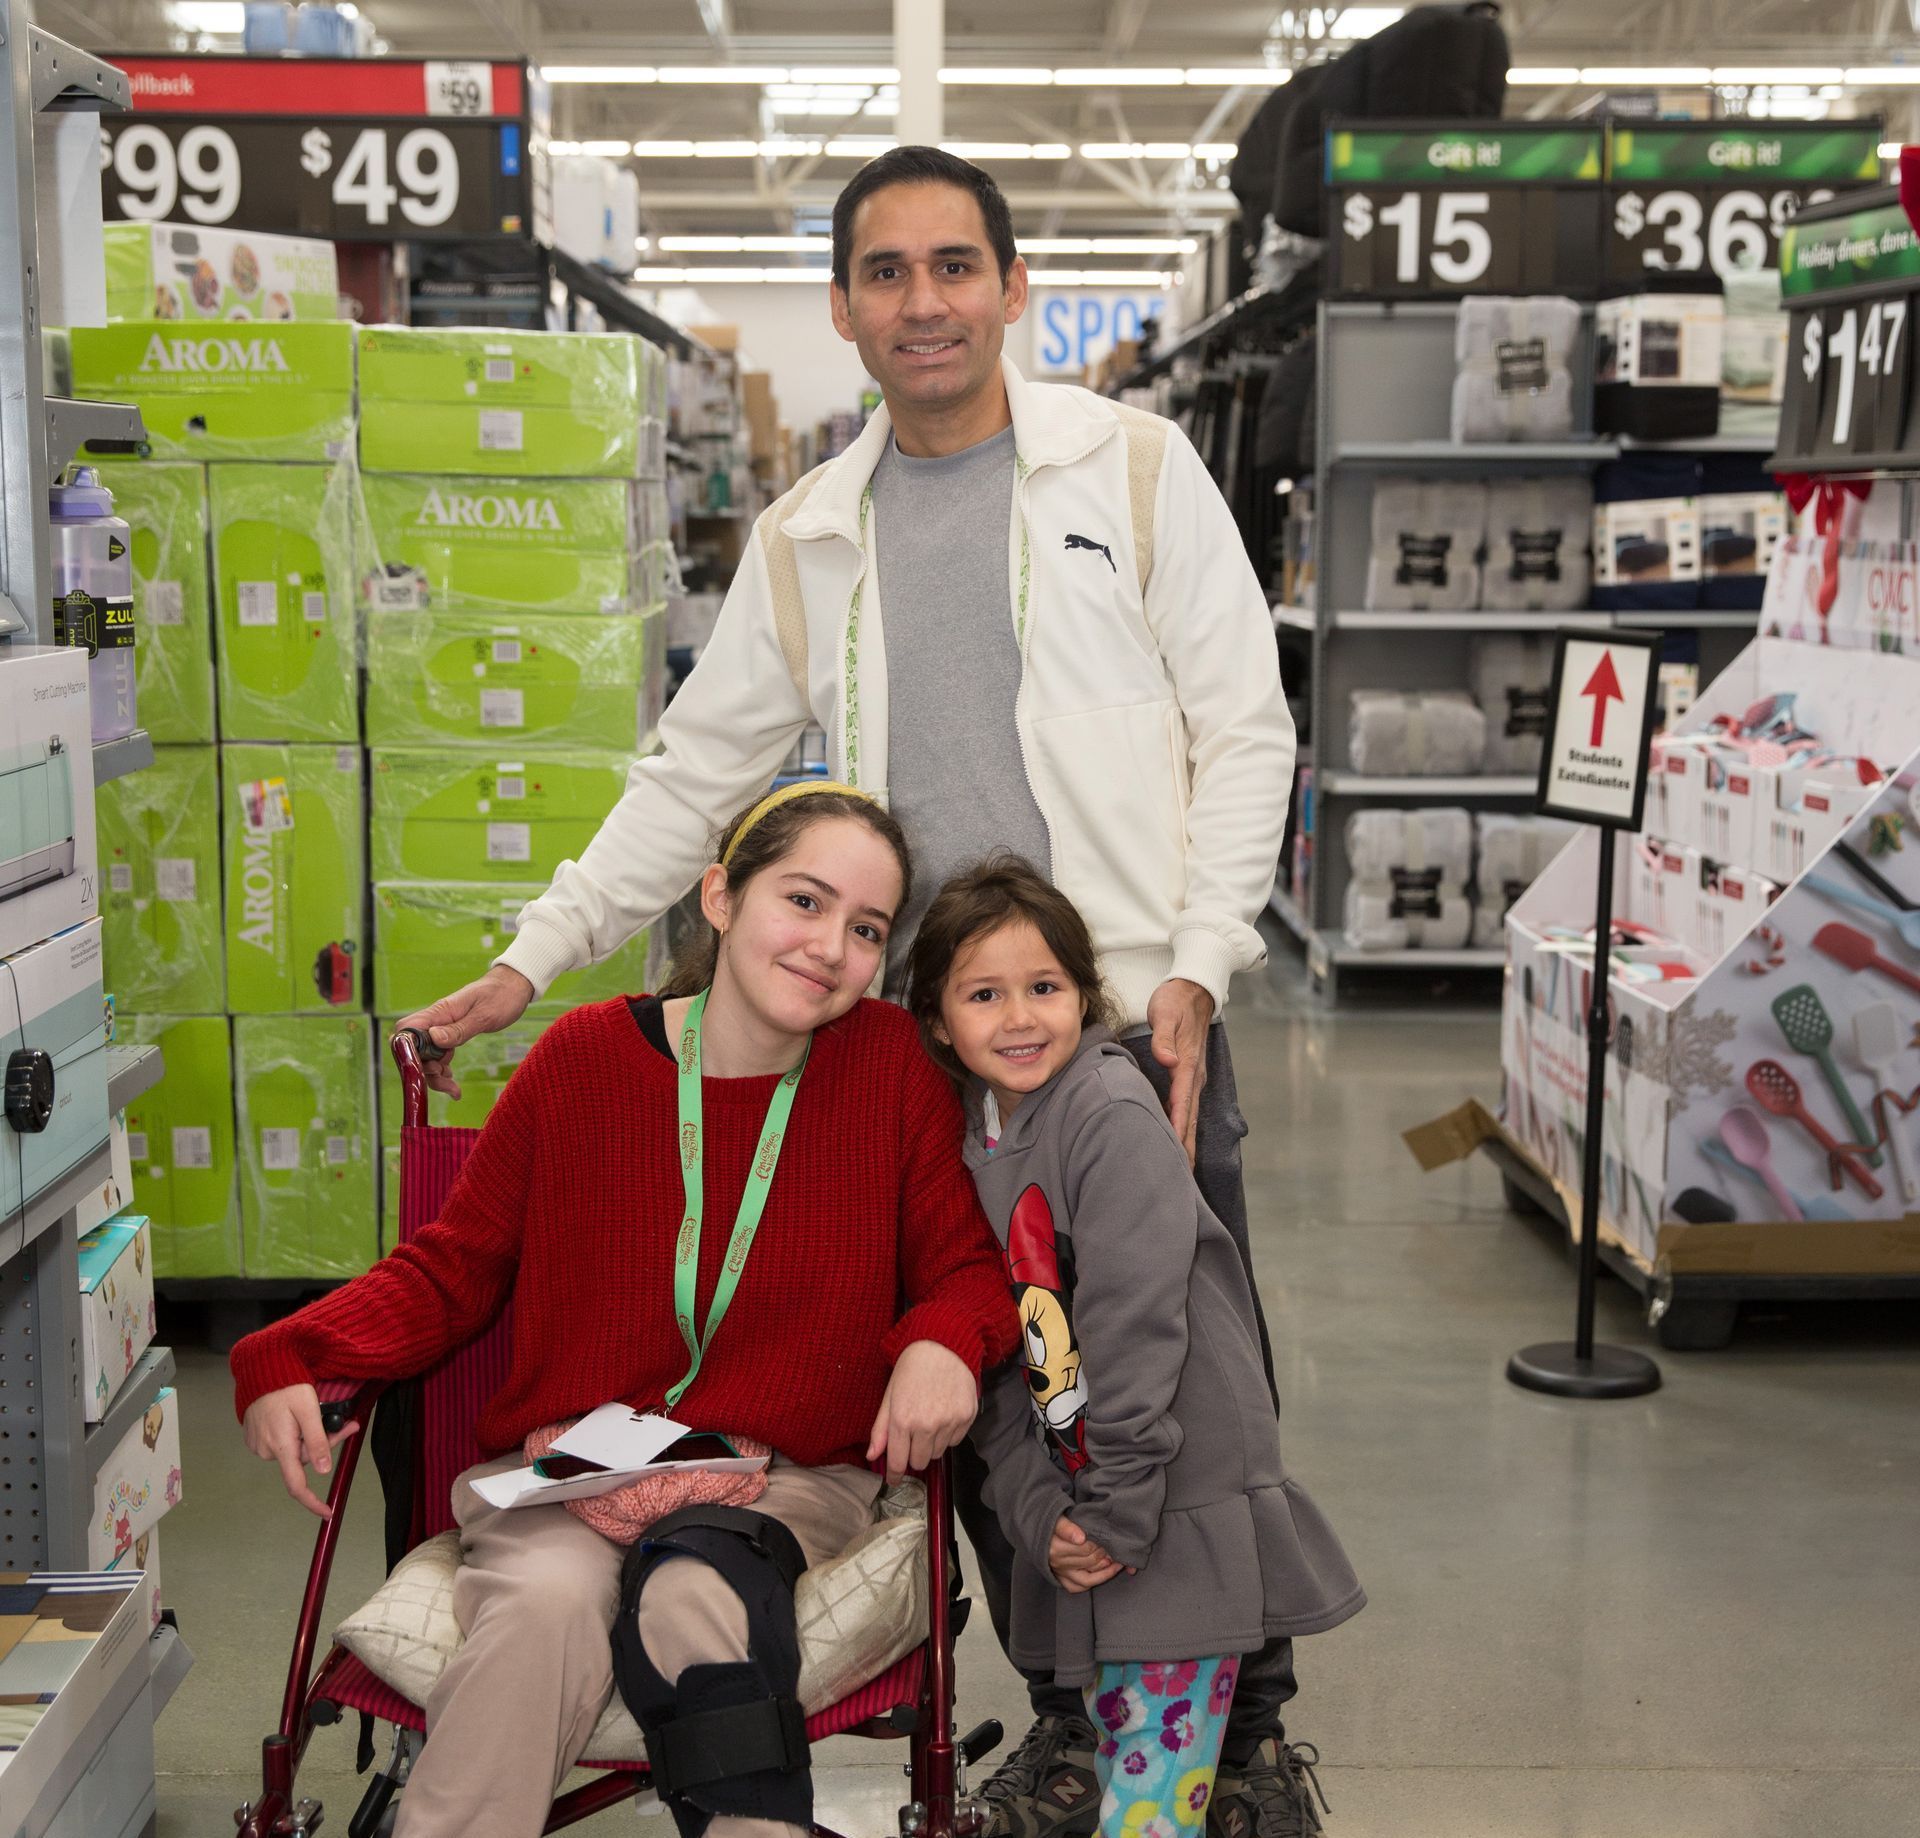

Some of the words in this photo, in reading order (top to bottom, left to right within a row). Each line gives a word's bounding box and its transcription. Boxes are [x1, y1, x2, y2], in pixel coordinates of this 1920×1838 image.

[130, 73, 195, 96] ollback
[1427, 142, 1474, 168] Gift
[1707, 140, 1754, 167] Gift
[301, 127, 460, 227] $49
[1343, 192, 1492, 283] $15
[1044, 296, 1164, 367] SPO
[139, 330, 291, 372] AROMA
[415, 487, 564, 531] AROMA
[1568, 748, 1623, 768] Students
[1557, 766, 1630, 790] Estudiantes
[80, 875, 95, 903] 2X
[1052, 1775, 1087, 1805] N
